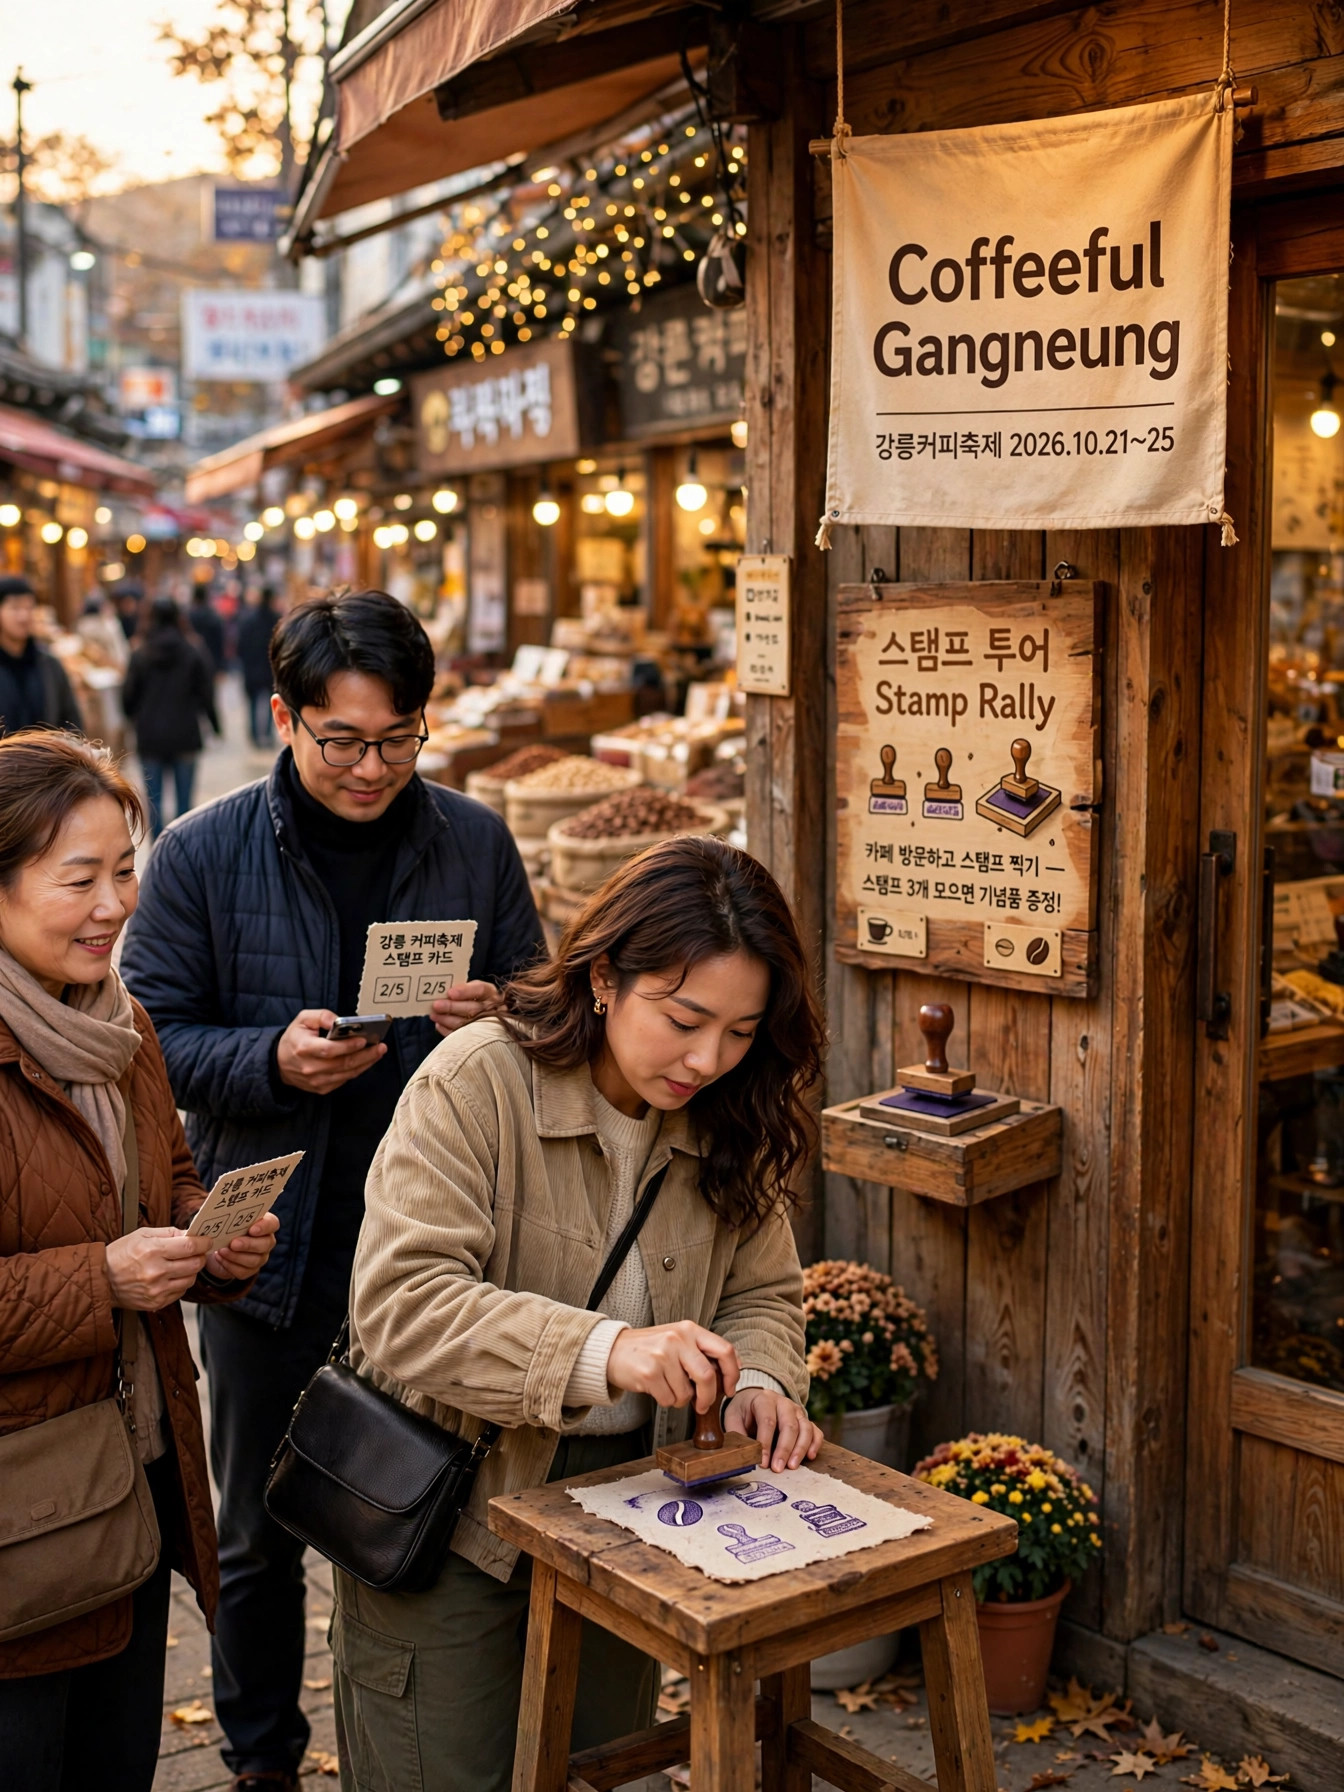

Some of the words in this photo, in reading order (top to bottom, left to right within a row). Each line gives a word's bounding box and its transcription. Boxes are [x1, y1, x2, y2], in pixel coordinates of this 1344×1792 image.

[889, 220, 1164, 305] Coffeeful
[873, 320, 1180, 388] Gangneung
[876, 431, 1001, 460] 강릉커피축제
[1009, 426, 1175, 457] 2026.10.21~25
[878, 627, 973, 672] 스탬프
[983, 628, 1049, 672] 투어
[875, 680, 968, 727] Stamp
[979, 682, 1056, 731] Rally
[865, 842, 894, 863] 카페
[899, 844, 955, 868] 방문하고
[960, 851, 1005, 873] 스탬프
[1009, 854, 1039, 877] 찍기
[862, 874, 902, 896] 스탬프
[906, 879, 929, 899] 3개
[933, 882, 975, 905] 모으면
[979, 885, 1022, 909] 기념품
[1026, 890, 1061, 913] 증정!
[380, 934, 406, 949] 강릉
[410, 933, 463, 948] 커피축제
[383, 952, 423, 967] 스탬프
[428, 951, 453, 965] 카드
[380, 983, 404, 997] 2/5
[423, 981, 446, 995] 2/5
[233, 1211, 256, 1227] 2/5
